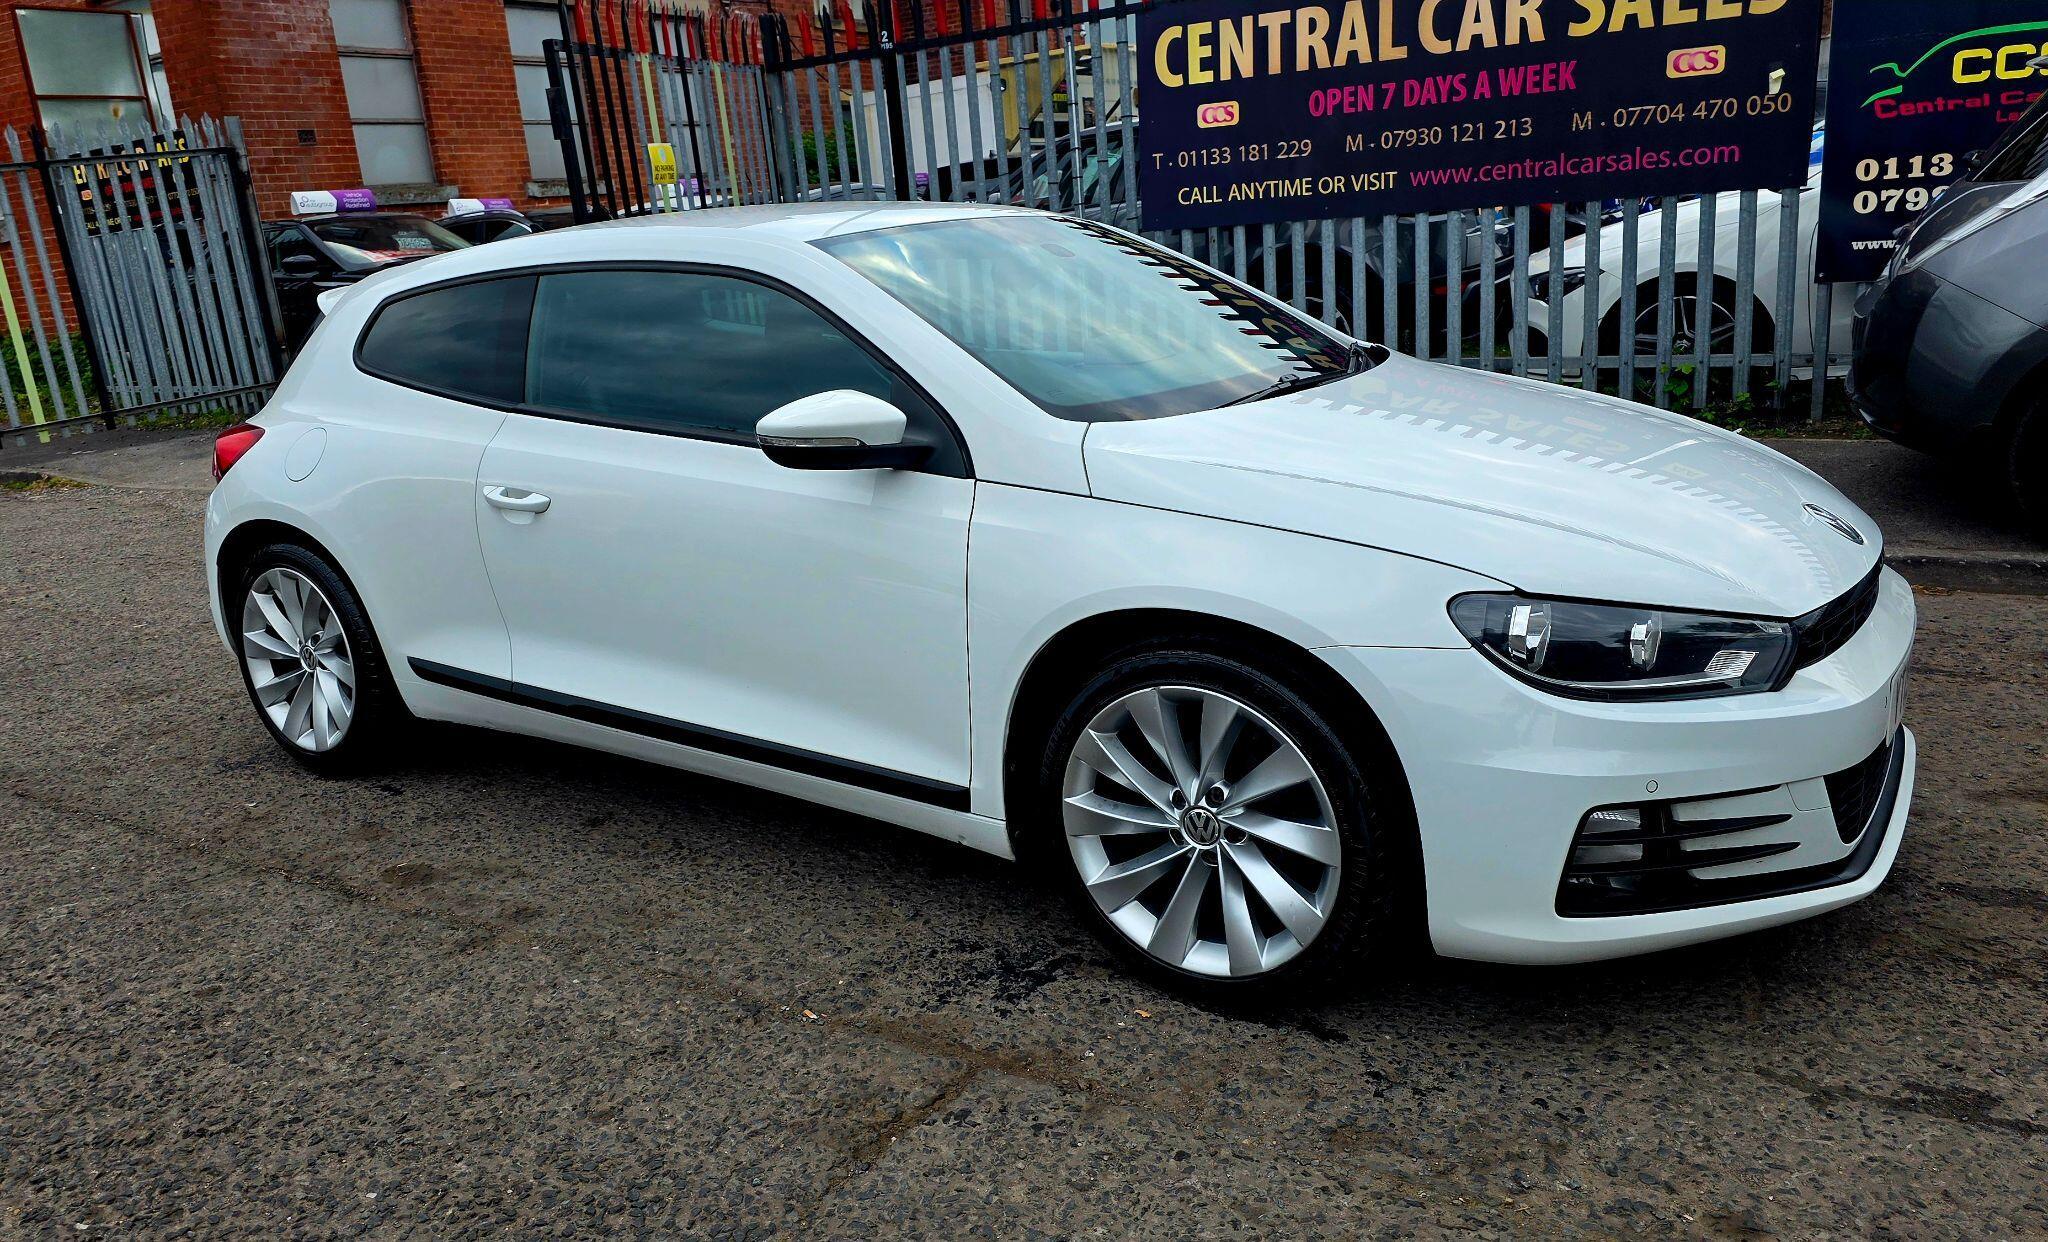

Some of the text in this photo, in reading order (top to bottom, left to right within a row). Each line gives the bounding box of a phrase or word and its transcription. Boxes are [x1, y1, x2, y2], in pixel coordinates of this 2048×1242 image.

[881, 30, 888, 42] 2
[1155, 0, 1408, 88] CENTRAL
[1418, 0, 1546, 54] CAR
[1672, 50, 1719, 74] CCS
[1952, 42, 2048, 84] CC
[1309, 60, 1577, 117] OPEN 7 DAYS A WEEK
[1202, 105, 1235, 125] CCS
[1613, 104, 1685, 128] 07704
[1693, 98, 1738, 120] 470
[1746, 92, 1792, 116] 050
[1874, 90, 2044, 119] Central Ca
[1381, 127, 1442, 149] 07930
[1451, 122, 1483, 143] 121
[1494, 117, 1533, 139] 213
[1178, 147, 1231, 168] 01133
[1239, 143, 1268, 162] 181
[1277, 140, 1312, 159] 229
[1855, 153, 1954, 182] 0113
[1178, 145, 1740, 205] CALL ANYTIME OR VISIT www.centralcarsales.com
